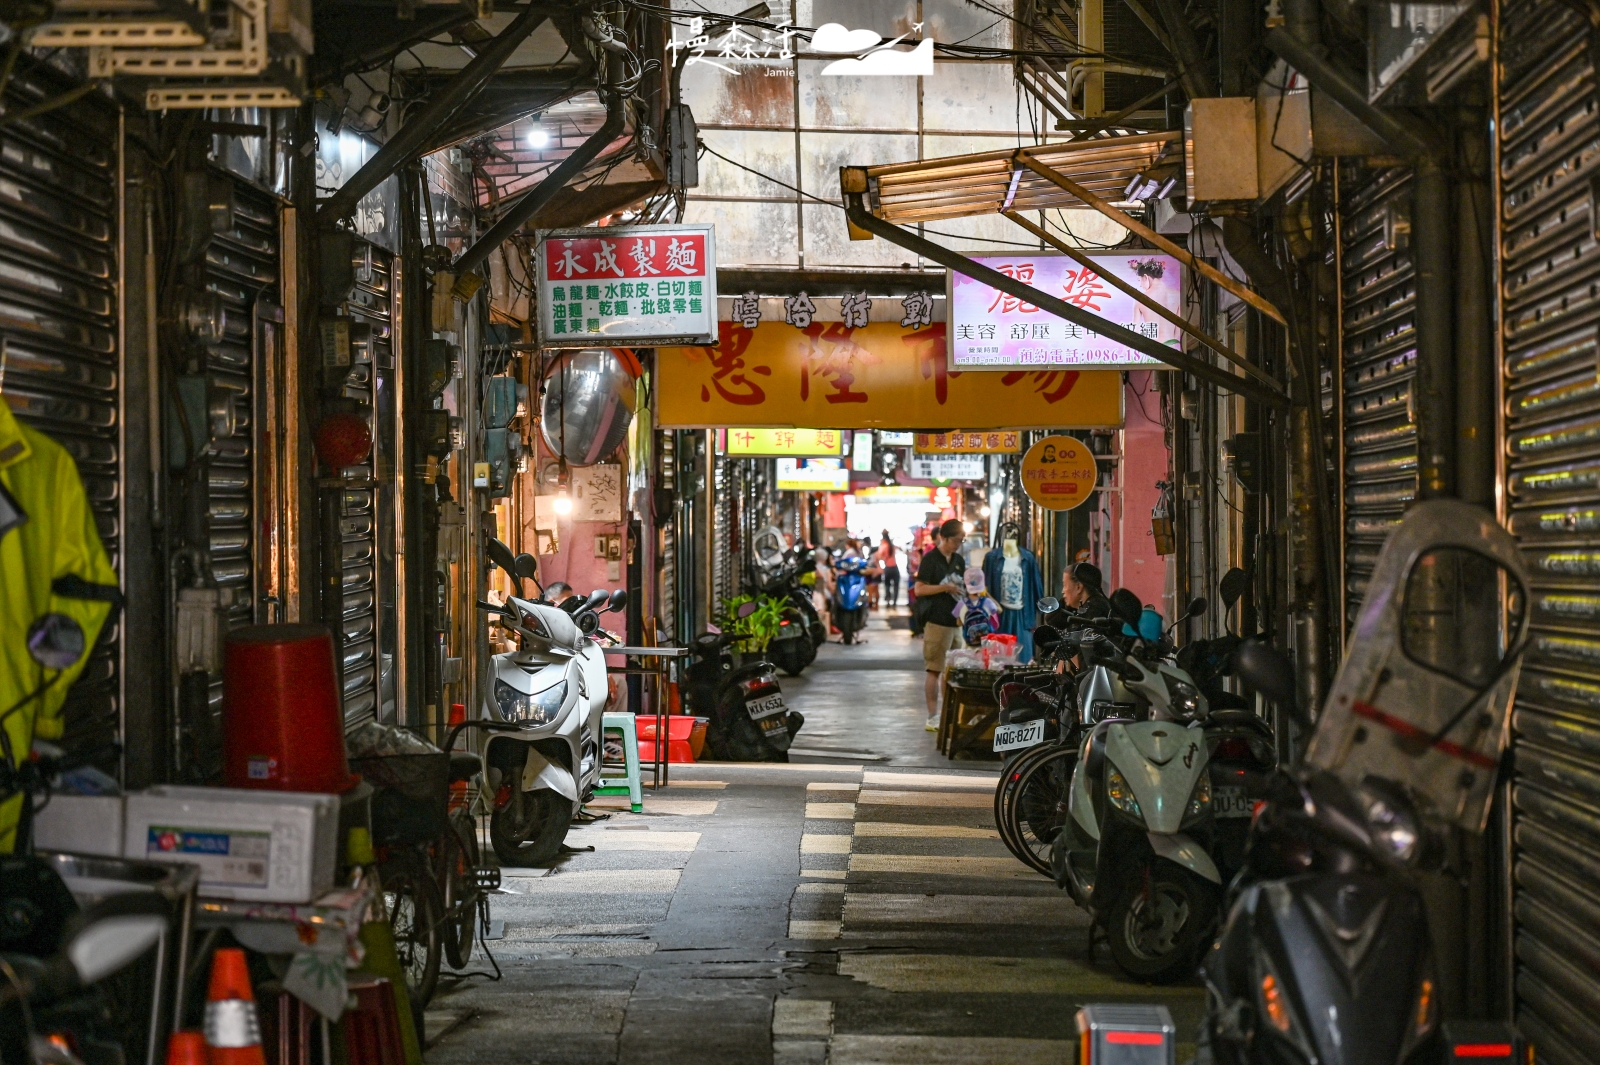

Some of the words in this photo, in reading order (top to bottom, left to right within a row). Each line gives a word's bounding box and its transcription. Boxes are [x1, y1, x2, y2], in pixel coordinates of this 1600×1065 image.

[554, 237, 699, 279] 永成製麵
[732, 290, 934, 330] 嘻哈行動
[553, 318, 600, 335] 廣東麵
[956, 323, 996, 340] 美容
[1010, 323, 1050, 340] 舒壓
[734, 431, 835, 449] 什錦麵
[917, 433, 1017, 449] 專業服飾修改
[748, 698, 785, 716] MXA-6532
[995, 726, 1041, 747] NQG-8271
